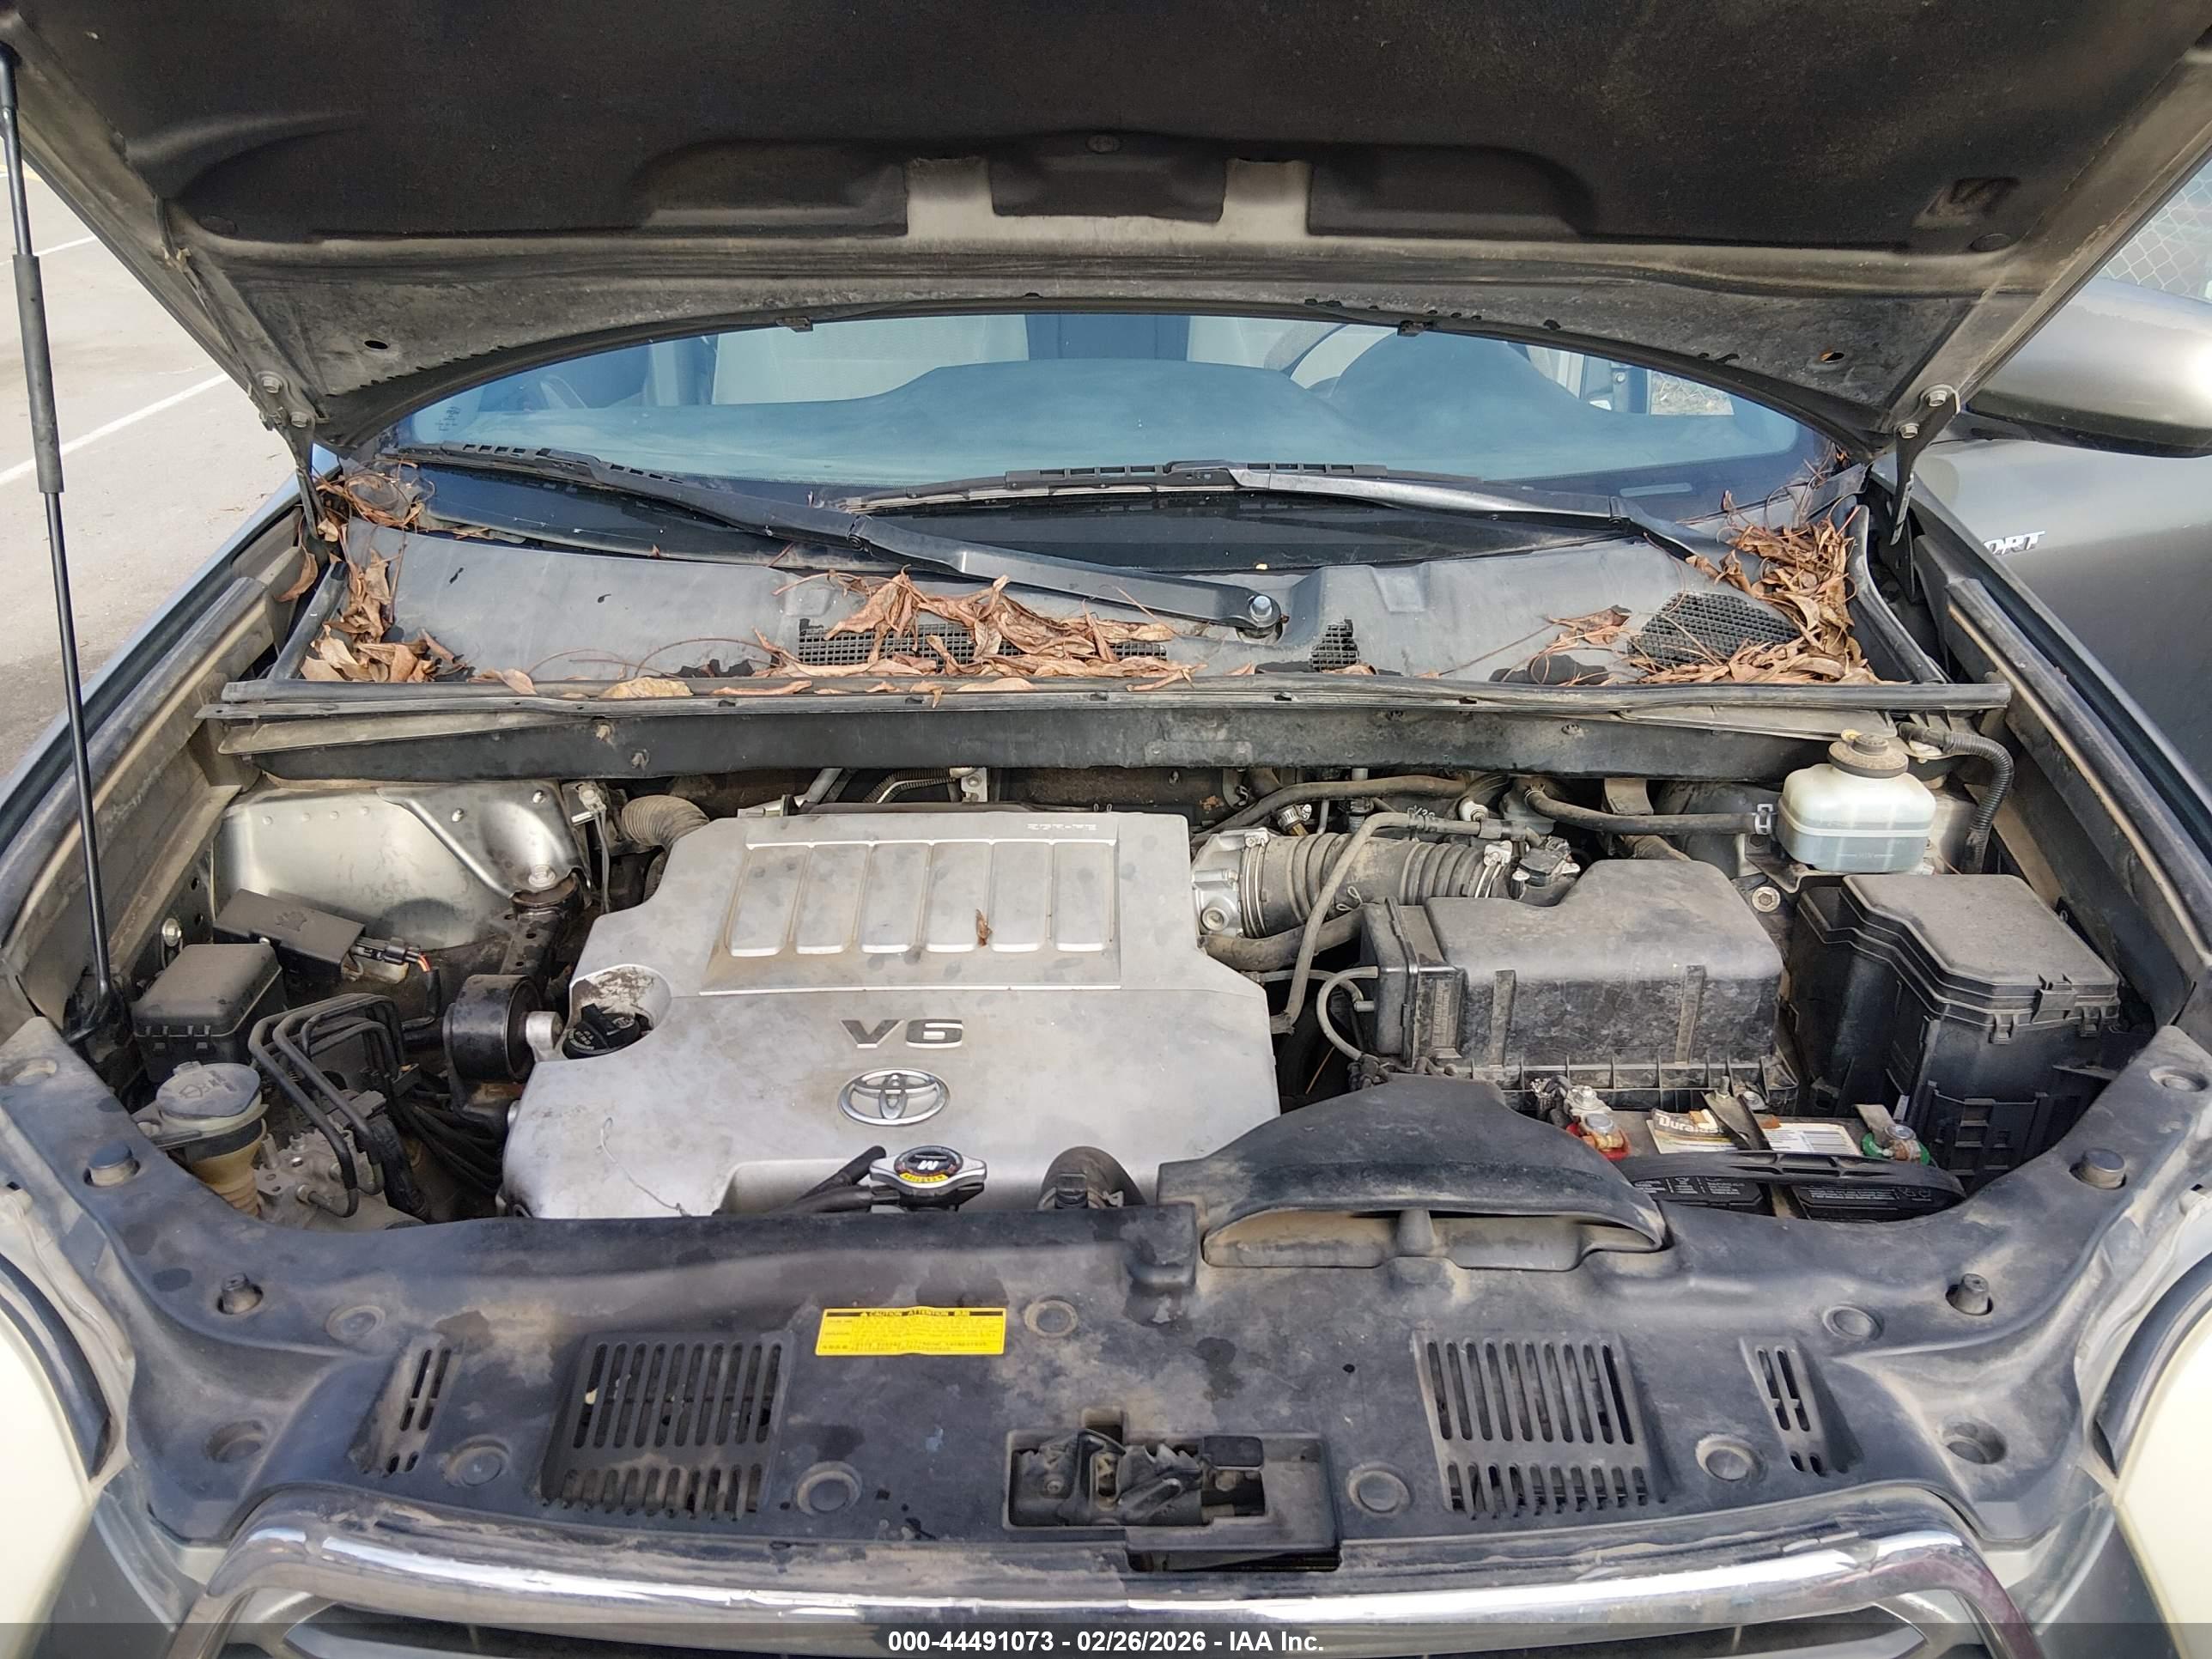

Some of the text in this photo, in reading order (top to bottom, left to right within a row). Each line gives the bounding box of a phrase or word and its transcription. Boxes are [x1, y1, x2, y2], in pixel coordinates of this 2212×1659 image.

[1984, 531, 2045, 555] ORT
[841, 1019, 963, 1048] V6
[1656, 1113, 1724, 1133] Duralast
[908, 1308, 949, 1317] ATTENTION
